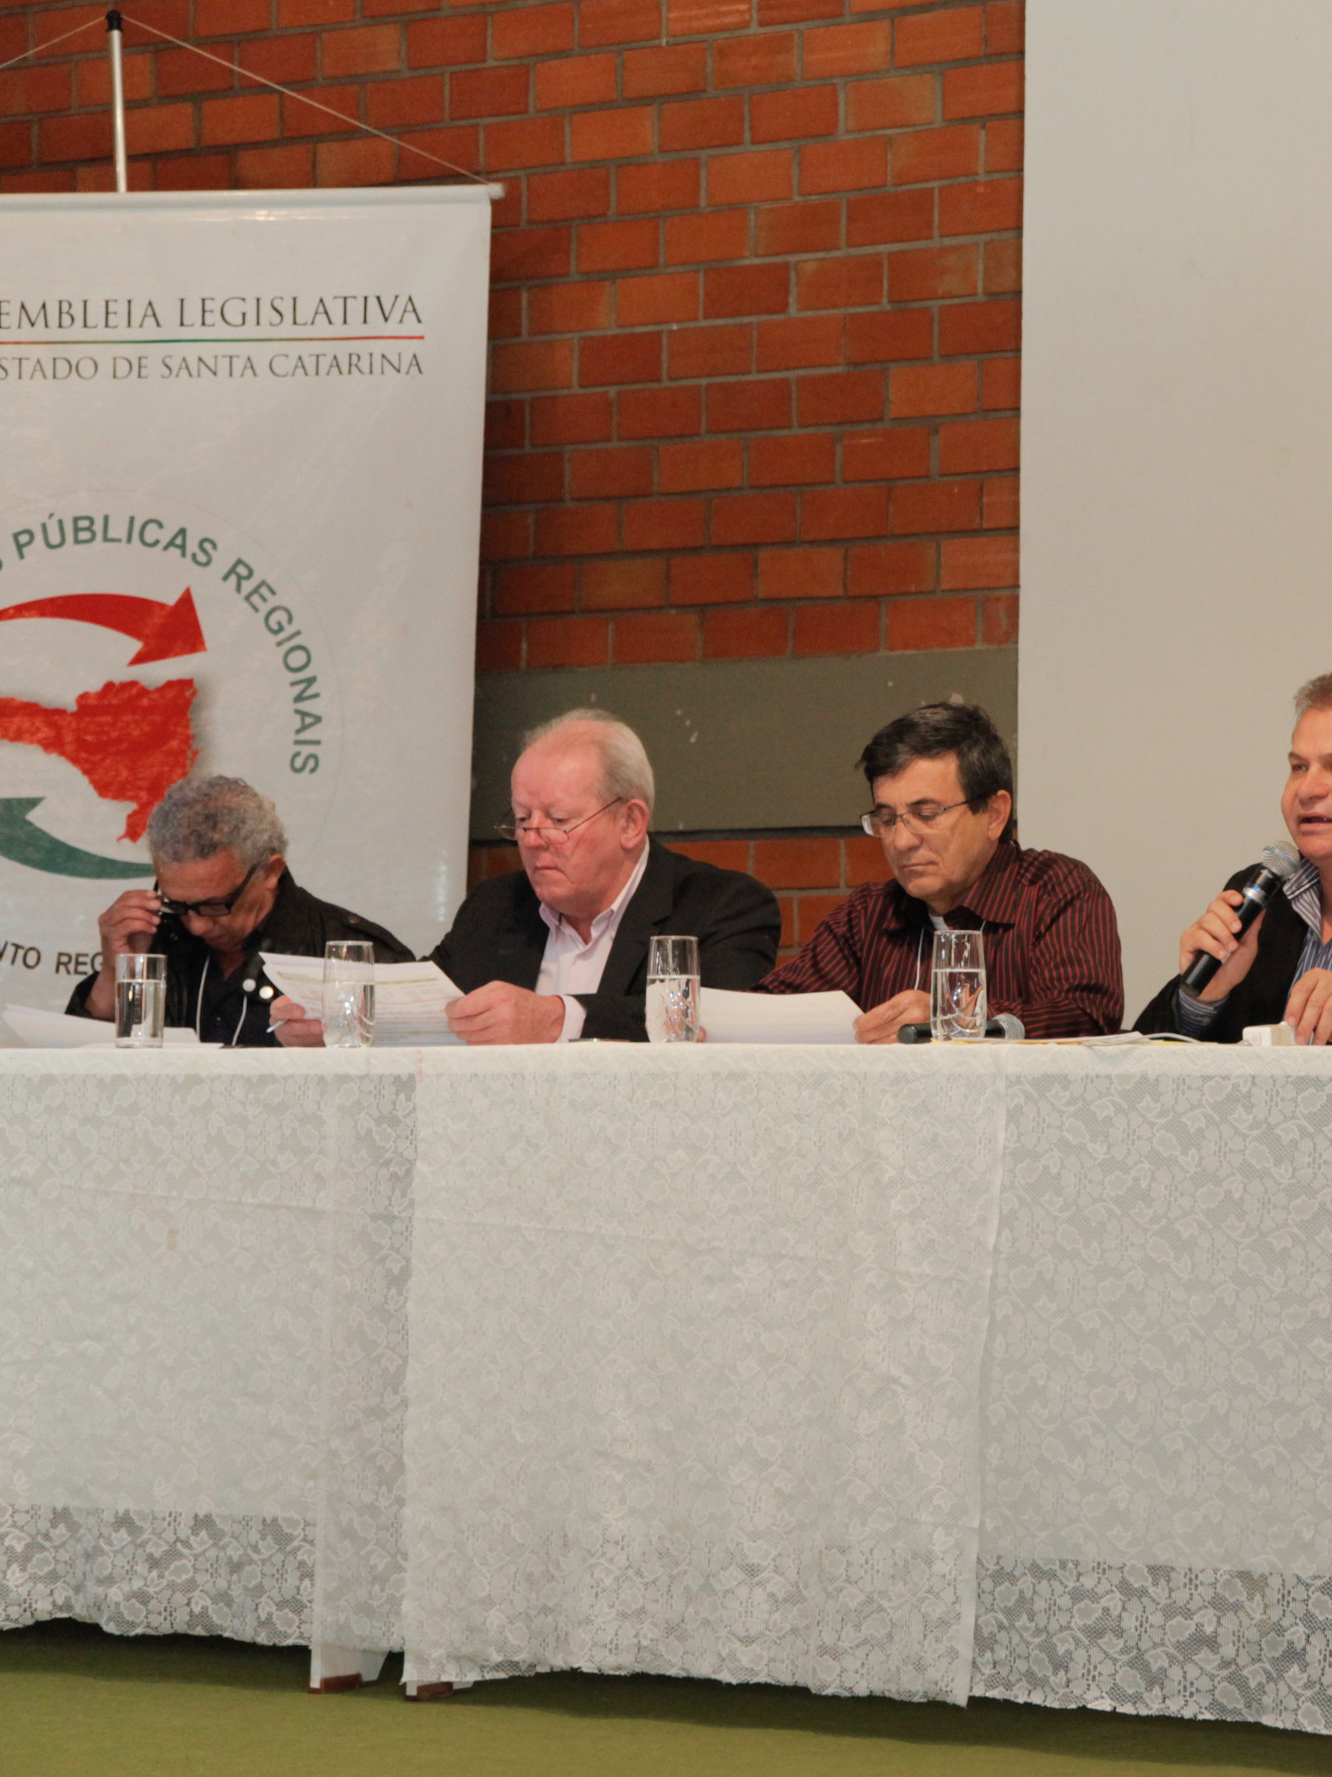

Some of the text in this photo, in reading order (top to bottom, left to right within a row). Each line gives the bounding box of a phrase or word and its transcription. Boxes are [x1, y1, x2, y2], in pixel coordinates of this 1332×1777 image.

[0, 294, 423, 330] EMBLEIA LEGISLATIVA
[112, 355, 149, 380] DE
[160, 354, 258, 379] SANTA
[268, 352, 424, 378] CATARINA
[12, 513, 323, 775] PÚBLICAS REGIONAIS
